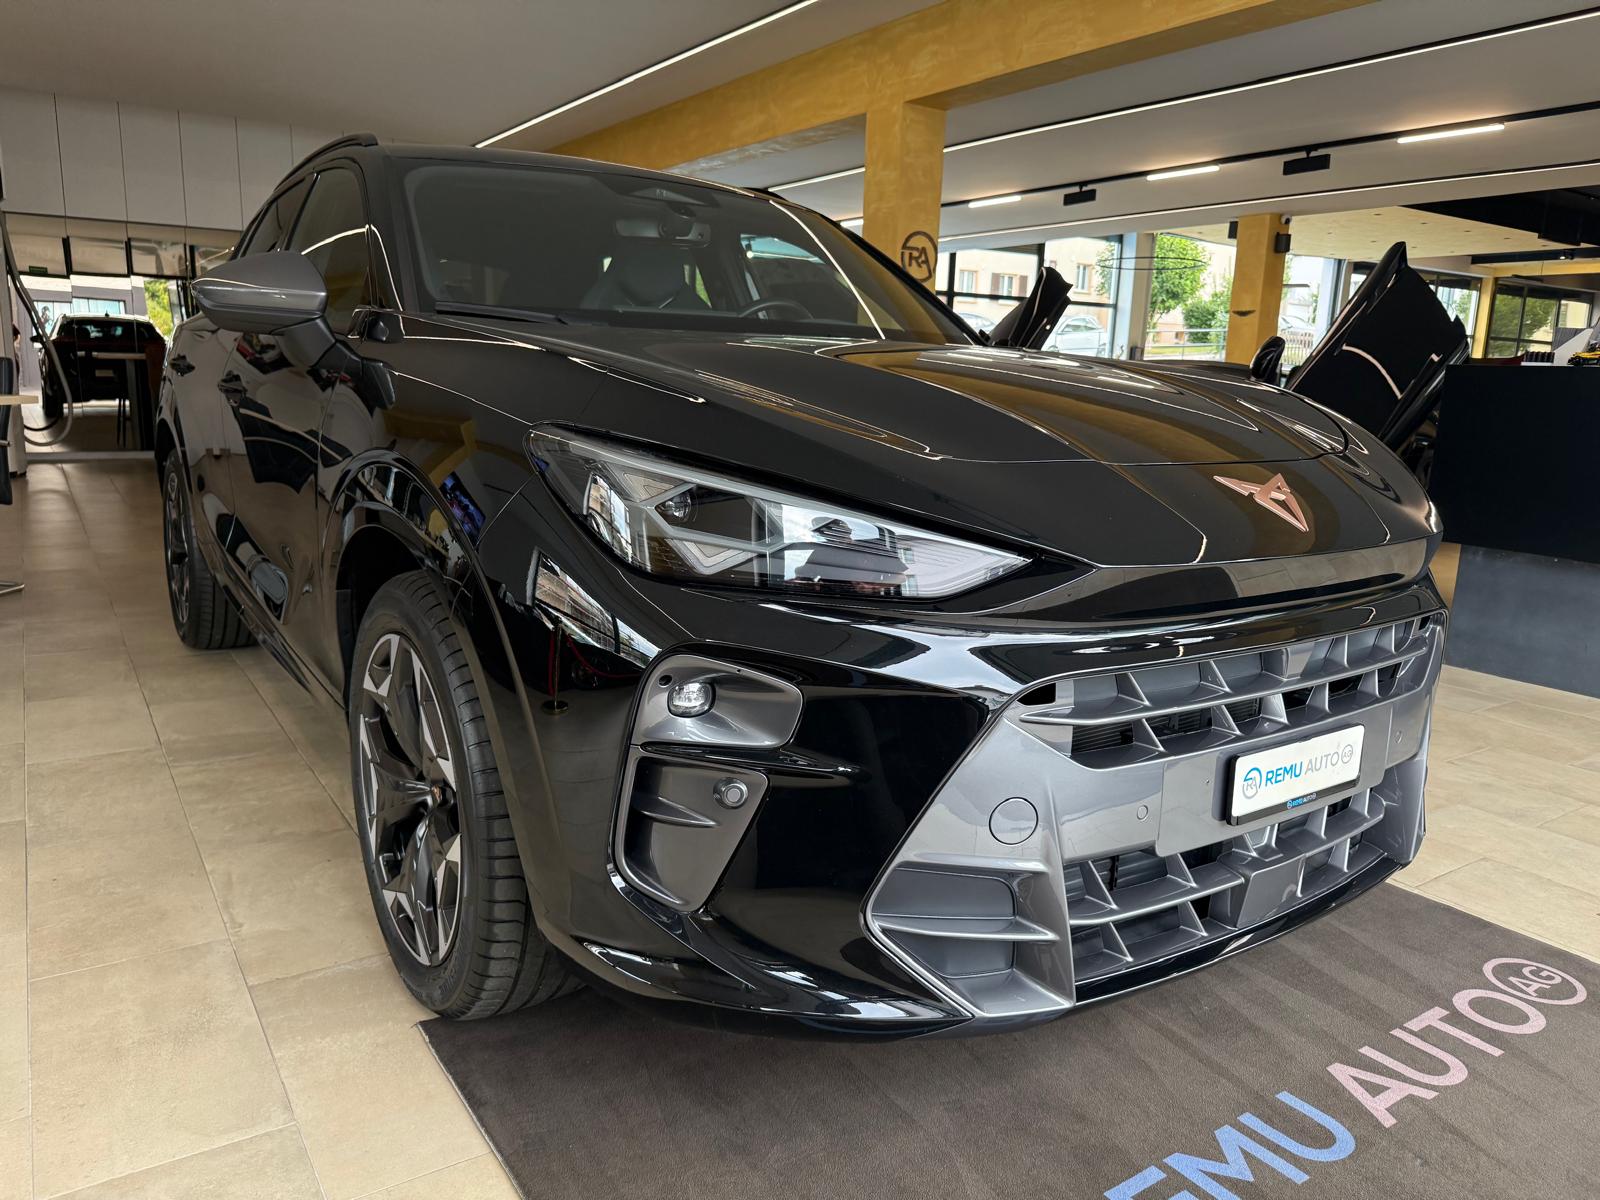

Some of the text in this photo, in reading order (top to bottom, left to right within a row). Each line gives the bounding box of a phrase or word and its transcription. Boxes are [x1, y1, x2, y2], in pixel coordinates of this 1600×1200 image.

[1265, 761, 1303, 787] REMU
[1305, 751, 1340, 775] AUTO
[1326, 989, 1547, 1128] AUTO
[1507, 966, 1563, 997] AG
